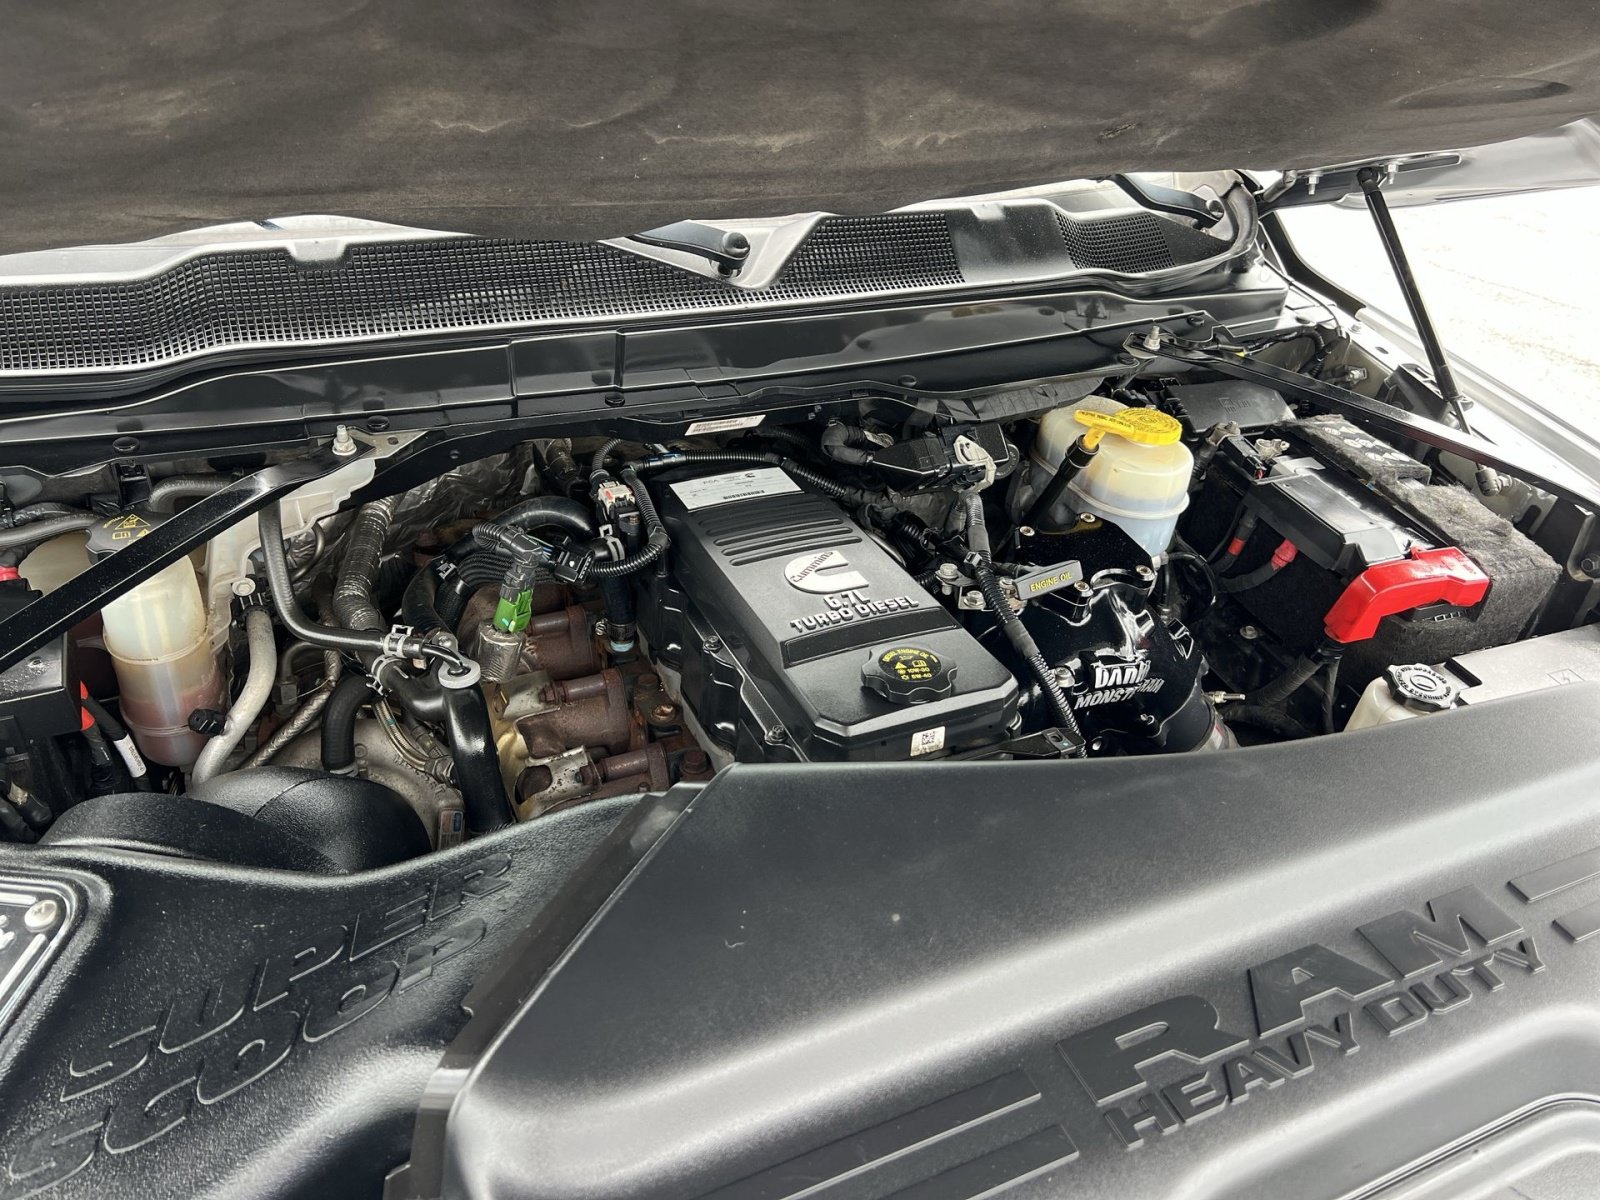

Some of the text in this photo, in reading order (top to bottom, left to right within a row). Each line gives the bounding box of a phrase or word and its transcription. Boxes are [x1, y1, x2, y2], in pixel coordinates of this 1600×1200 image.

[790, 551, 834, 583] Cummins
[1029, 571, 1073, 593] ENGINE OIL
[790, 595, 919, 633] TURBO DIESEL
[823, 589, 870, 611] 6.7L
[61, 852, 512, 1102] SUPER
[1056, 884, 1525, 1106] RAM
[1103, 936, 1546, 1151] HEAVY DUTY
